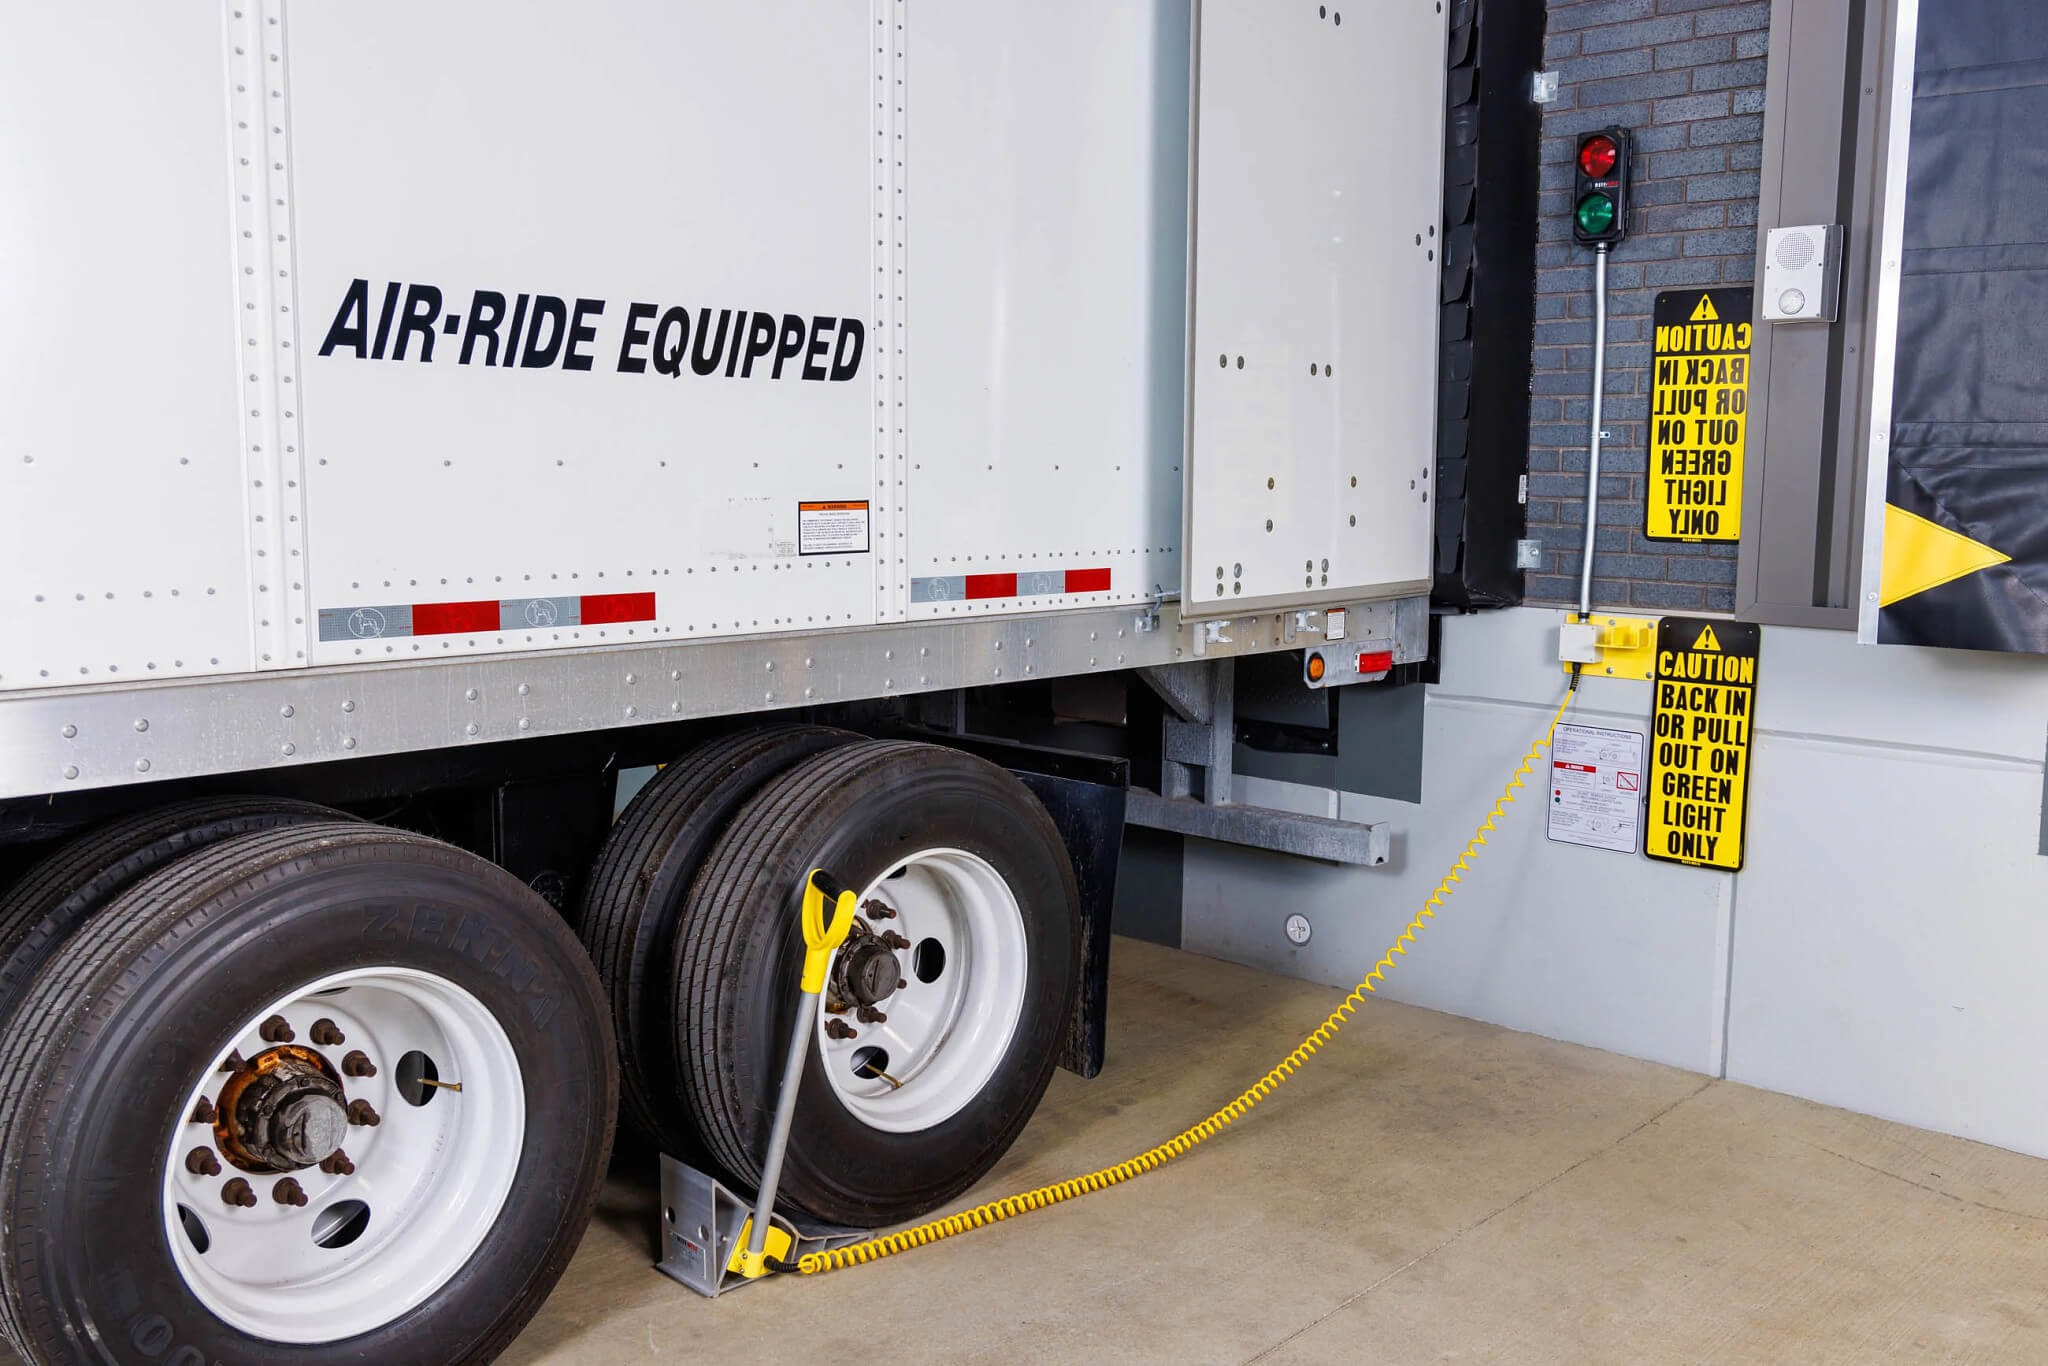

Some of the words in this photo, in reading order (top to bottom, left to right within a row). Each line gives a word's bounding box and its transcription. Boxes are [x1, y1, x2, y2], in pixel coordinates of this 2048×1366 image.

[318, 278, 605, 372] AIR-RIDE
[617, 302, 865, 382] EQUIPPED
[1658, 651, 1754, 684] CAUTION
[1661, 683, 1719, 713] BACK
[1725, 689, 1747, 717] IN
[1656, 713, 1685, 740] OR
[1692, 716, 1745, 747] PULL
[1660, 742, 1702, 771] OUT
[1710, 748, 1739, 776] ON
[1662, 772, 1732, 805] GREEN
[1663, 800, 1726, 833] LIGHT
[1667, 830, 1718, 861] ONLY
